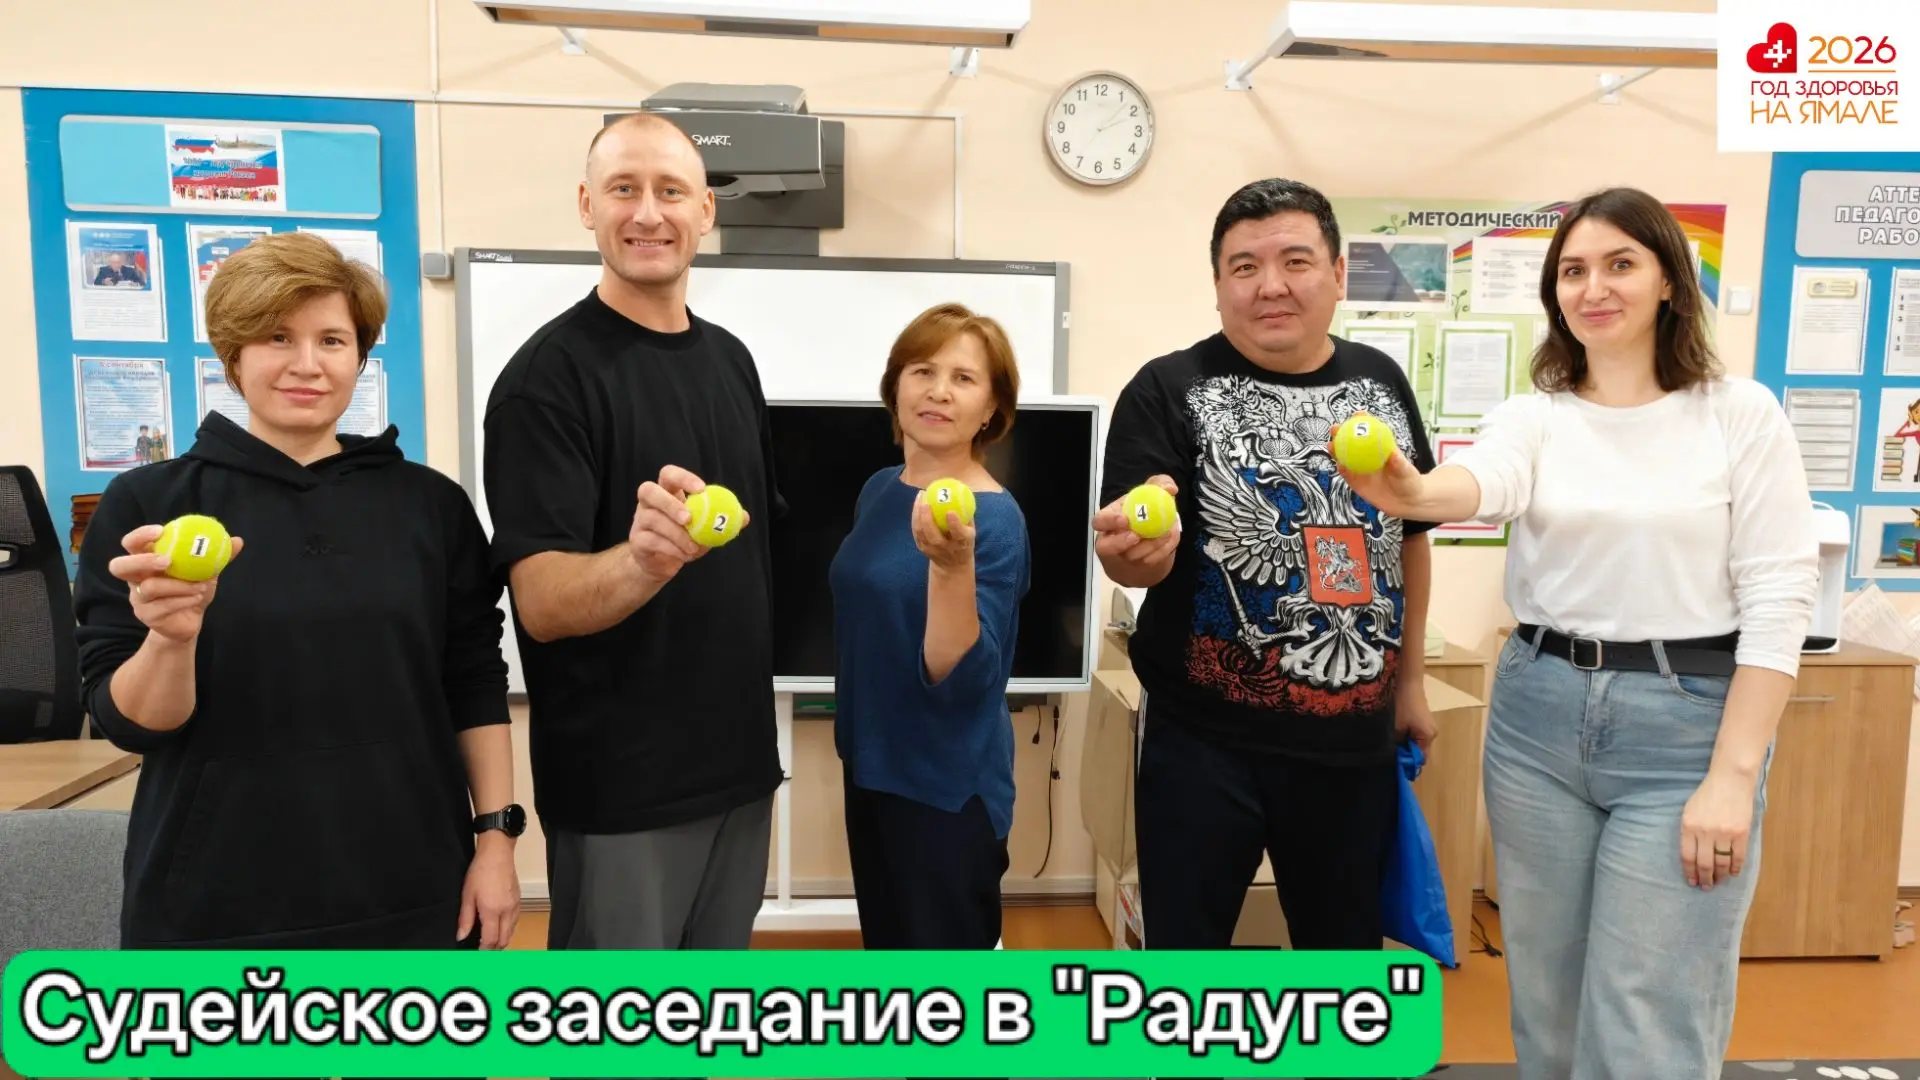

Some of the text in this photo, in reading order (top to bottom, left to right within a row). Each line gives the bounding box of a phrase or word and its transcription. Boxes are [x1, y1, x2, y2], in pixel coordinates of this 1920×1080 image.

[1077, 89, 1088, 101] 11
[1094, 83, 1108, 97] 12
[1119, 90, 1125, 103] 1
[1063, 103, 1076, 116] 10
[1129, 105, 1138, 117] 2
[1057, 121, 1066, 134] 9
[1134, 125, 1143, 138] 3
[691, 134, 731, 147] SMART
[1062, 141, 1071, 154] 8
[1128, 142, 1137, 155] 4
[1076, 156, 1084, 168] 7
[1094, 161, 1103, 174] 6
[1113, 158, 1122, 170] 5
[1868, 185, 1920, 203] АТТЕ
[1408, 211, 1562, 228] МЕТОДИЧЕСКИЙ
[1356, 422, 1367, 436] 5
[939, 488, 949, 503] 3
[1137, 504, 1147, 520] 4
[713, 515, 726, 532] 2
[195, 537, 205, 556] 1
